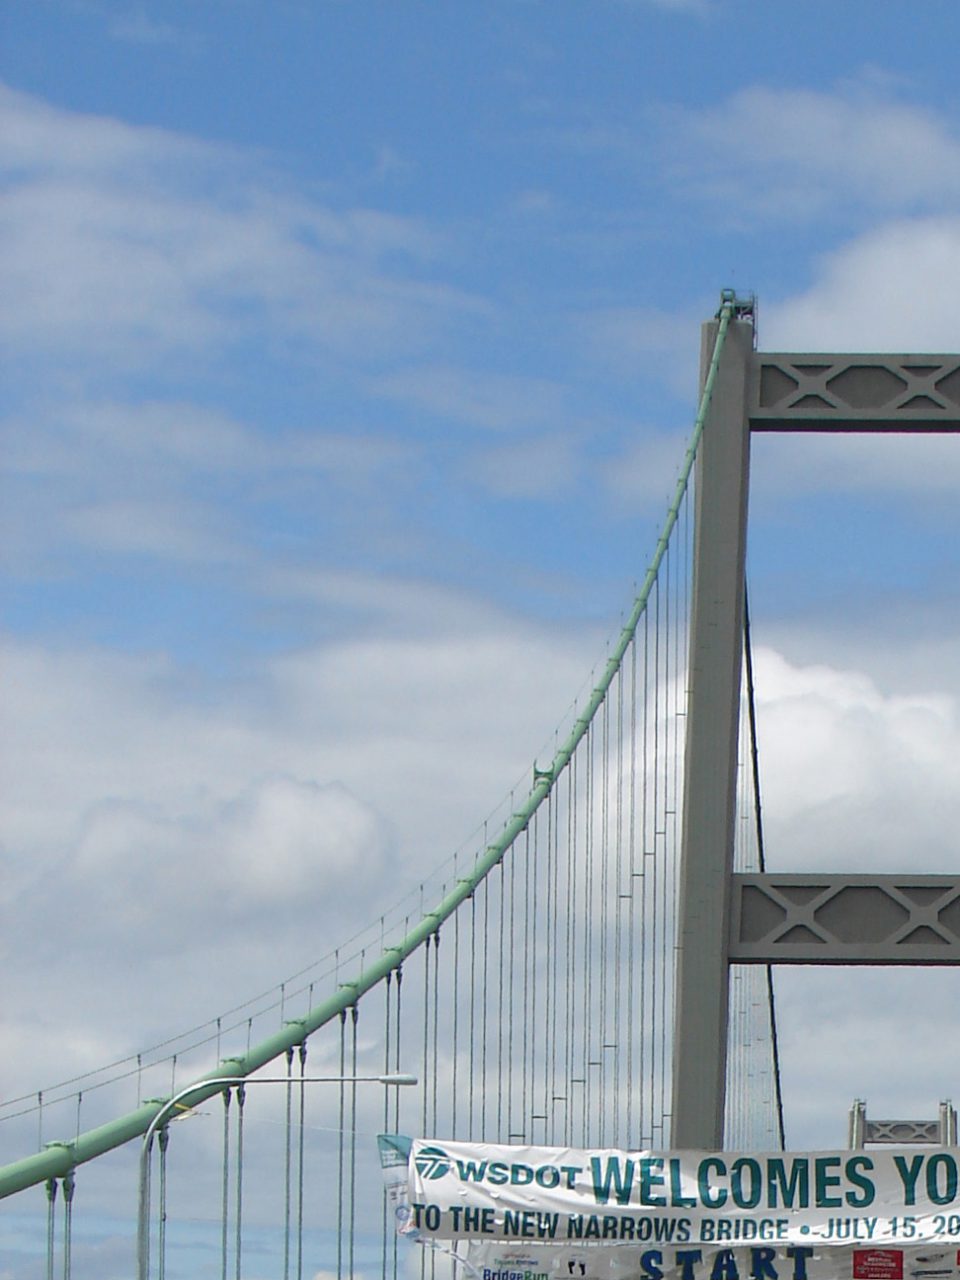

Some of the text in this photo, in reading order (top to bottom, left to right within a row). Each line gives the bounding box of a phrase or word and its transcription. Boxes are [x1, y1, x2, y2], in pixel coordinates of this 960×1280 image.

[455, 1160, 583, 1190] WSDOT
[590, 1155, 877, 1209] WELCOMES
[412, 1203, 441, 1232] TO
[449, 1205, 495, 1234] THE
[503, 1207, 559, 1239] NEW
[567, 1214, 692, 1242] NARROWS
[700, 1216, 789, 1242] BRIDGE
[819, 1216, 877, 1240] JULY
